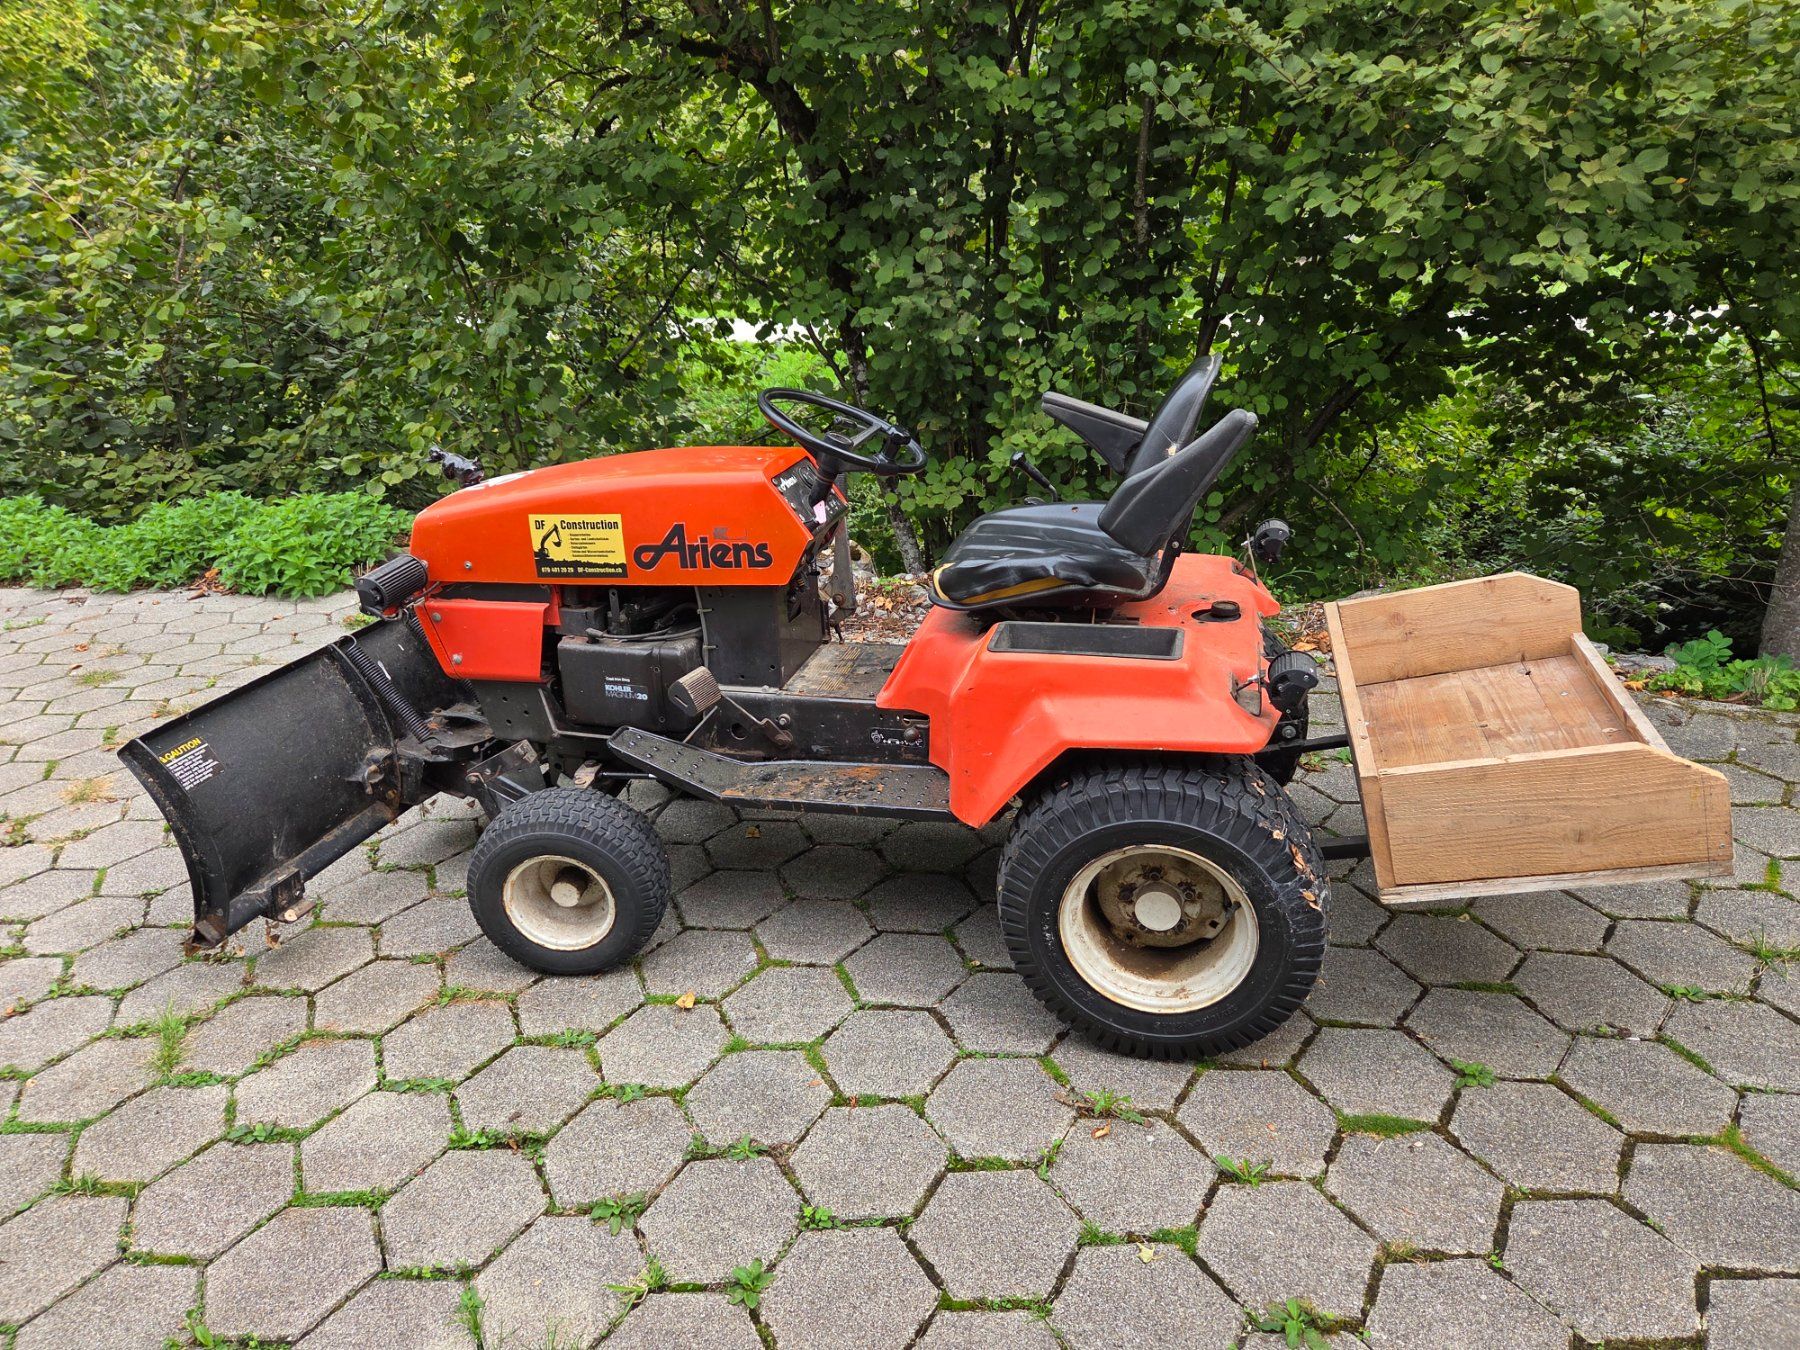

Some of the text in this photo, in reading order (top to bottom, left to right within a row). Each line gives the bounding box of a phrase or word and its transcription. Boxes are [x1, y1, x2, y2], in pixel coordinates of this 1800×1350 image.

[535, 519, 619, 530] DF Construction
[633, 522, 774, 571] Ariens
[605, 684, 633, 692] KOHLER
[165, 738, 201, 760] CAUTION
